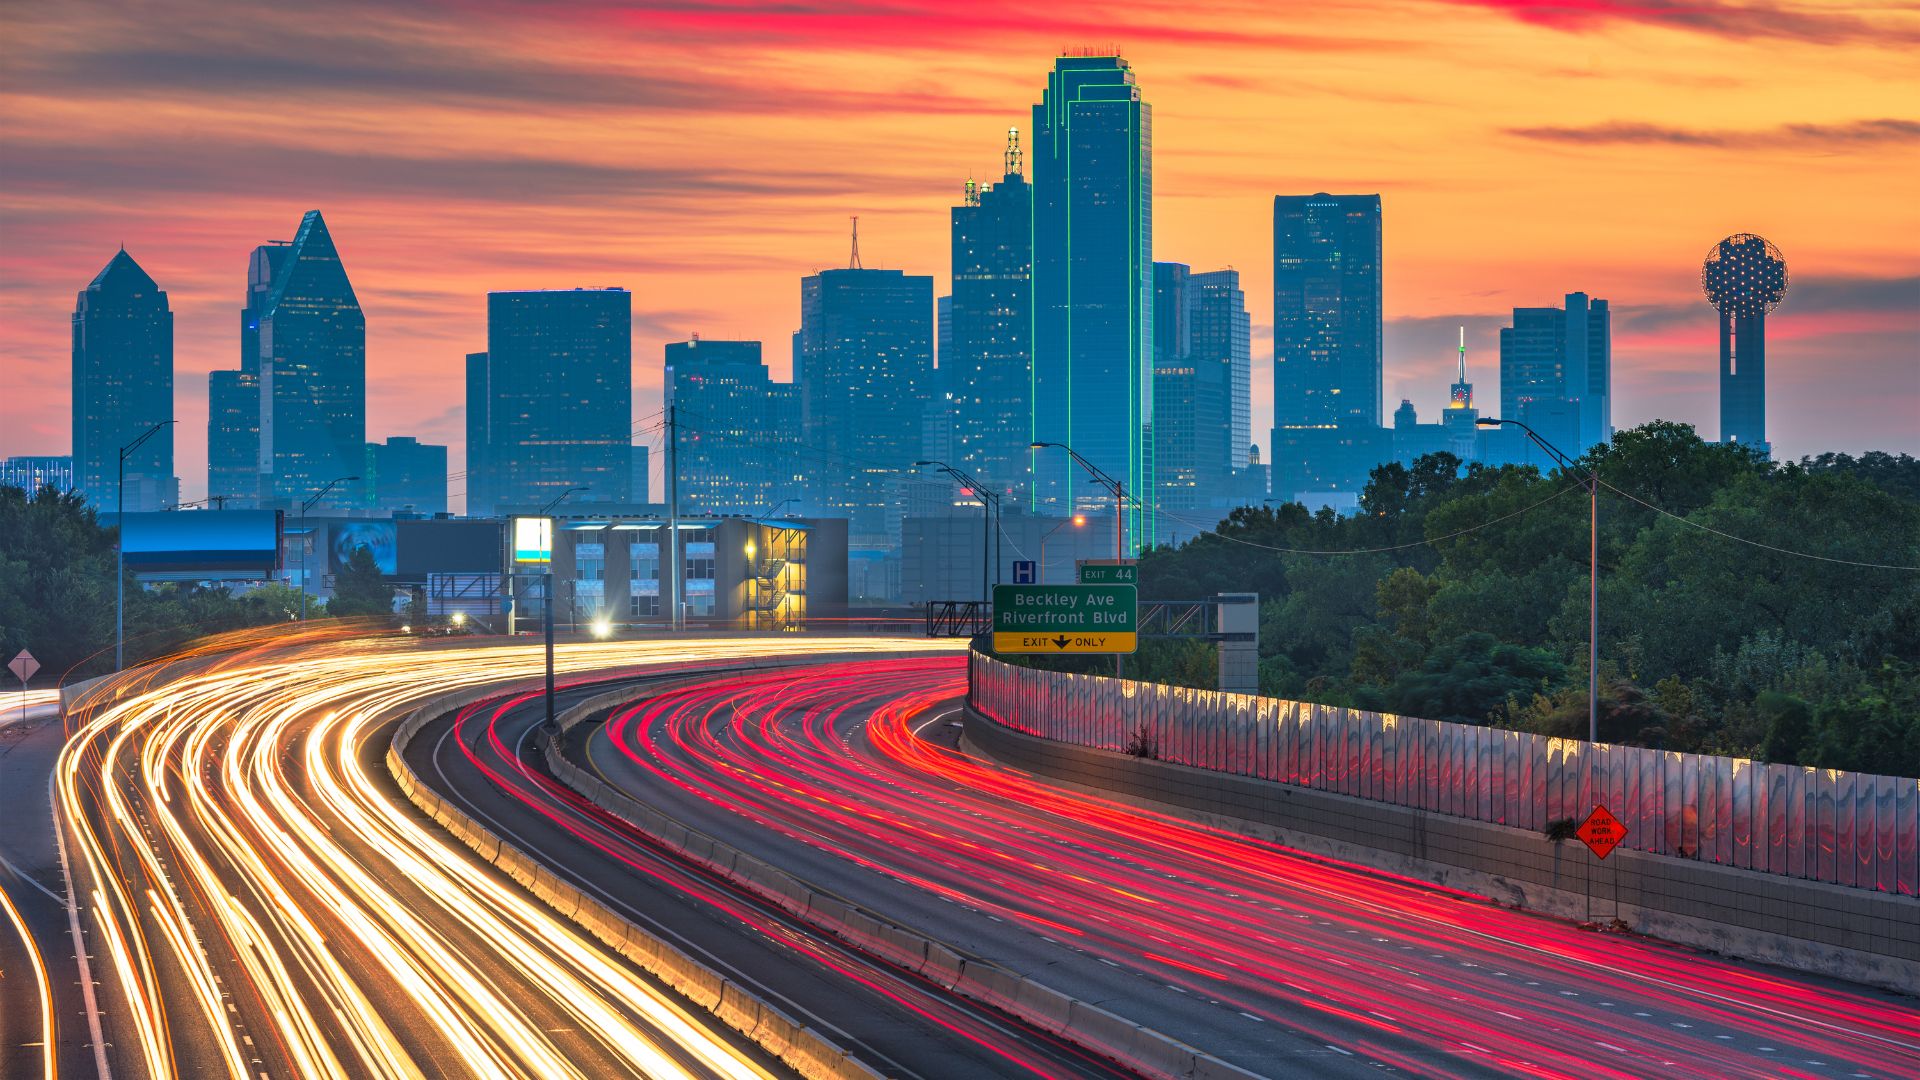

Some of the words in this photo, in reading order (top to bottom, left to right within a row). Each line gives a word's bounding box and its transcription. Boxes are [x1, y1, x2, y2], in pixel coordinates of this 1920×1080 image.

[1016, 562, 1033, 583] H
[1085, 570, 1105, 579] EXIT
[1115, 569, 1133, 580] 44
[1015, 593, 1078, 608] Beckley
[1086, 594, 1115, 606] Ave
[1003, 611, 1085, 624] Riverfront
[1093, 611, 1128, 624] Blvd
[1023, 637, 1048, 646] EXIT
[1075, 637, 1106, 647] ONLY
